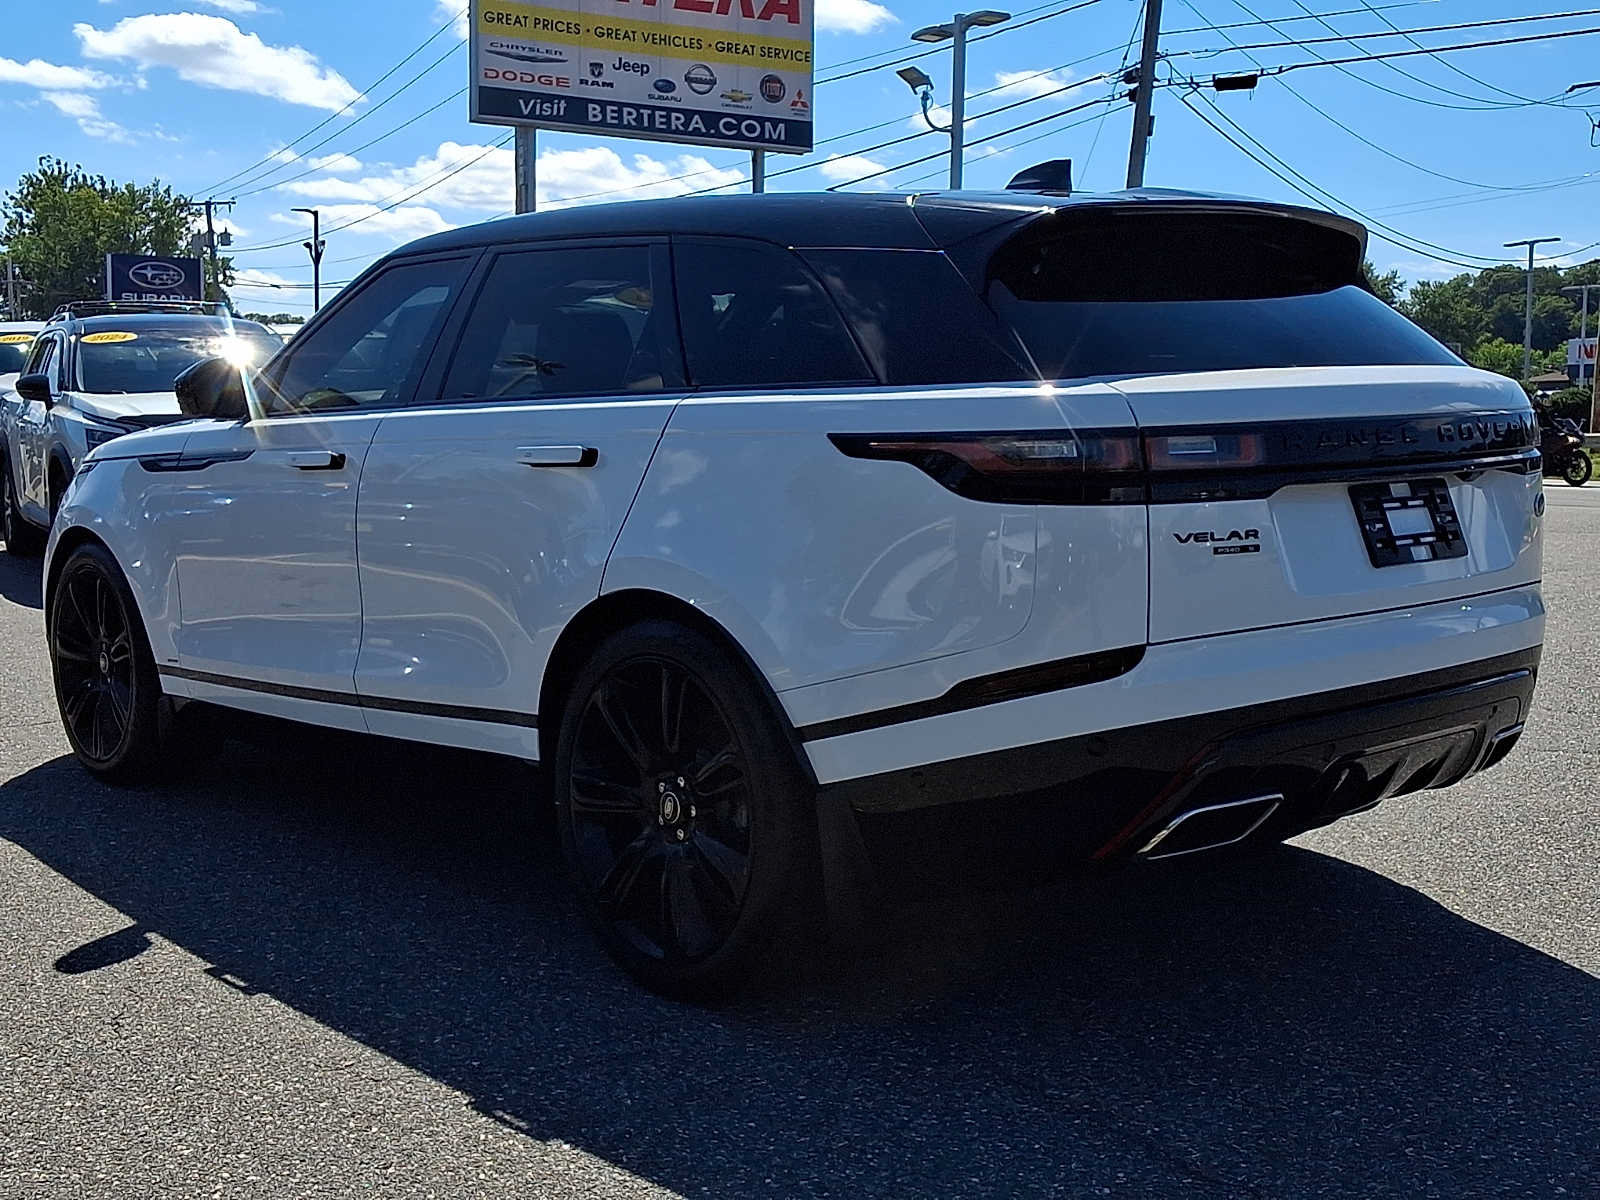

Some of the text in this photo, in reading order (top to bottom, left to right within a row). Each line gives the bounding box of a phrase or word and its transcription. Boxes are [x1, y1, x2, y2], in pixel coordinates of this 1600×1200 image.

[484, 11, 811, 63] GREAT PRICES GREAT VEHICLES GREAT SERVICE
[489, 41, 563, 56] CHRYSLER
[612, 57, 650, 76] Jeep
[483, 68, 570, 88] DODGE
[579, 78, 614, 89] RAM
[648, 93, 682, 103] SUBARU
[519, 99, 785, 141] Visit BERTERA.COM
[1173, 529, 1259, 543] VELAR
